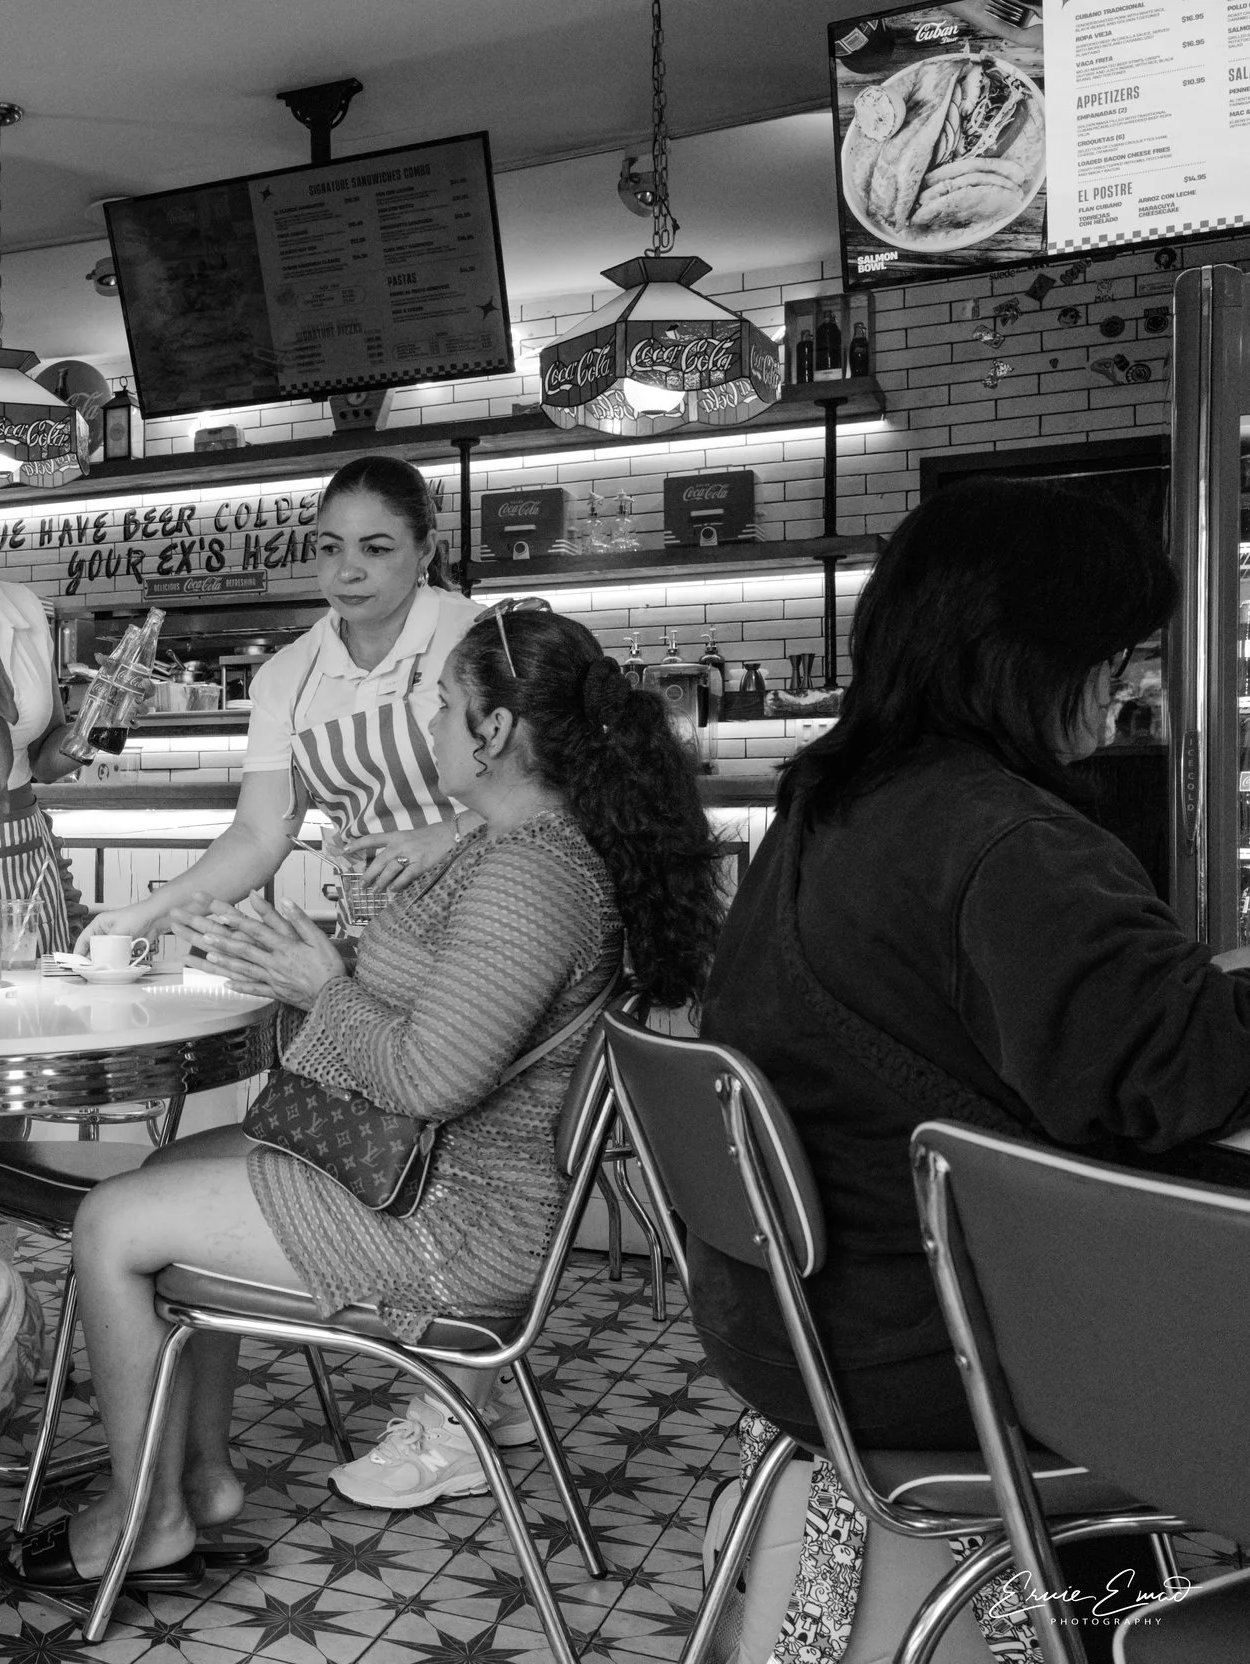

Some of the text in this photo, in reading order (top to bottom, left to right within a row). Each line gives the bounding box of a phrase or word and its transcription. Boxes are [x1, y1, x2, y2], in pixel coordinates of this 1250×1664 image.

[1076, 2, 1145, 20] CUBANO TRADICIONAL
[1227, 3, 1247, 11] POLLO
[1181, 13, 1204, 23] $16.95
[915, 20, 959, 42] Cuban
[1076, 30, 1112, 42] ROPA VIEJA
[1182, 38, 1205, 48] $16.95
[1076, 56, 1113, 68] VACA FRITA
[1228, 65, 1250, 82] SAL
[1182, 76, 1205, 87] $10.95
[1076, 85, 1140, 110] APPETIZERS
[1077, 109, 1116, 121] EMPANADAS
[1078, 133, 1125, 147] CROQUETAS (6)
[1078, 146, 1170, 167] LOADED BACON CHEESE FRIES
[309, 163, 431, 196] SIGNATURE SANDWICHES COMBO
[1184, 173, 1206, 183] $14.95
[1078, 182, 1132, 203] EL POSTRE
[1139, 195, 1159, 203] ARROZ
[1176, 190, 1196, 198] LECHE
[1079, 201, 1122, 213] FLAN CUBANO
[1139, 207, 1179, 218] CHEESECAKE
[1079, 212, 1110, 222] TORREJAS
[1094, 216, 1118, 225] HELADO
[857, 251, 898, 265] SALMON
[858, 261, 887, 274] BOWL
[387, 272, 417, 287] PASTAS
[989, 269, 1016, 281] suede
[629, 338, 735, 373] Coca-Cola
[545, 345, 614, 395] Coca-Cola
[682, 482, 733, 502] Coca-Cola
[498, 499, 543, 518] Coca-Cola
[39, 512, 110, 547] HAVE
[124, 504, 197, 542] BEER
[214, 491, 322, 532] COLDE
[65, 529, 318, 596] YOUR EX'S HEAR
[153, 582, 180, 592] DELICIOUS
[183, 576, 223, 593] Coca-Cola
[1187, 772, 1195, 811] COLD
